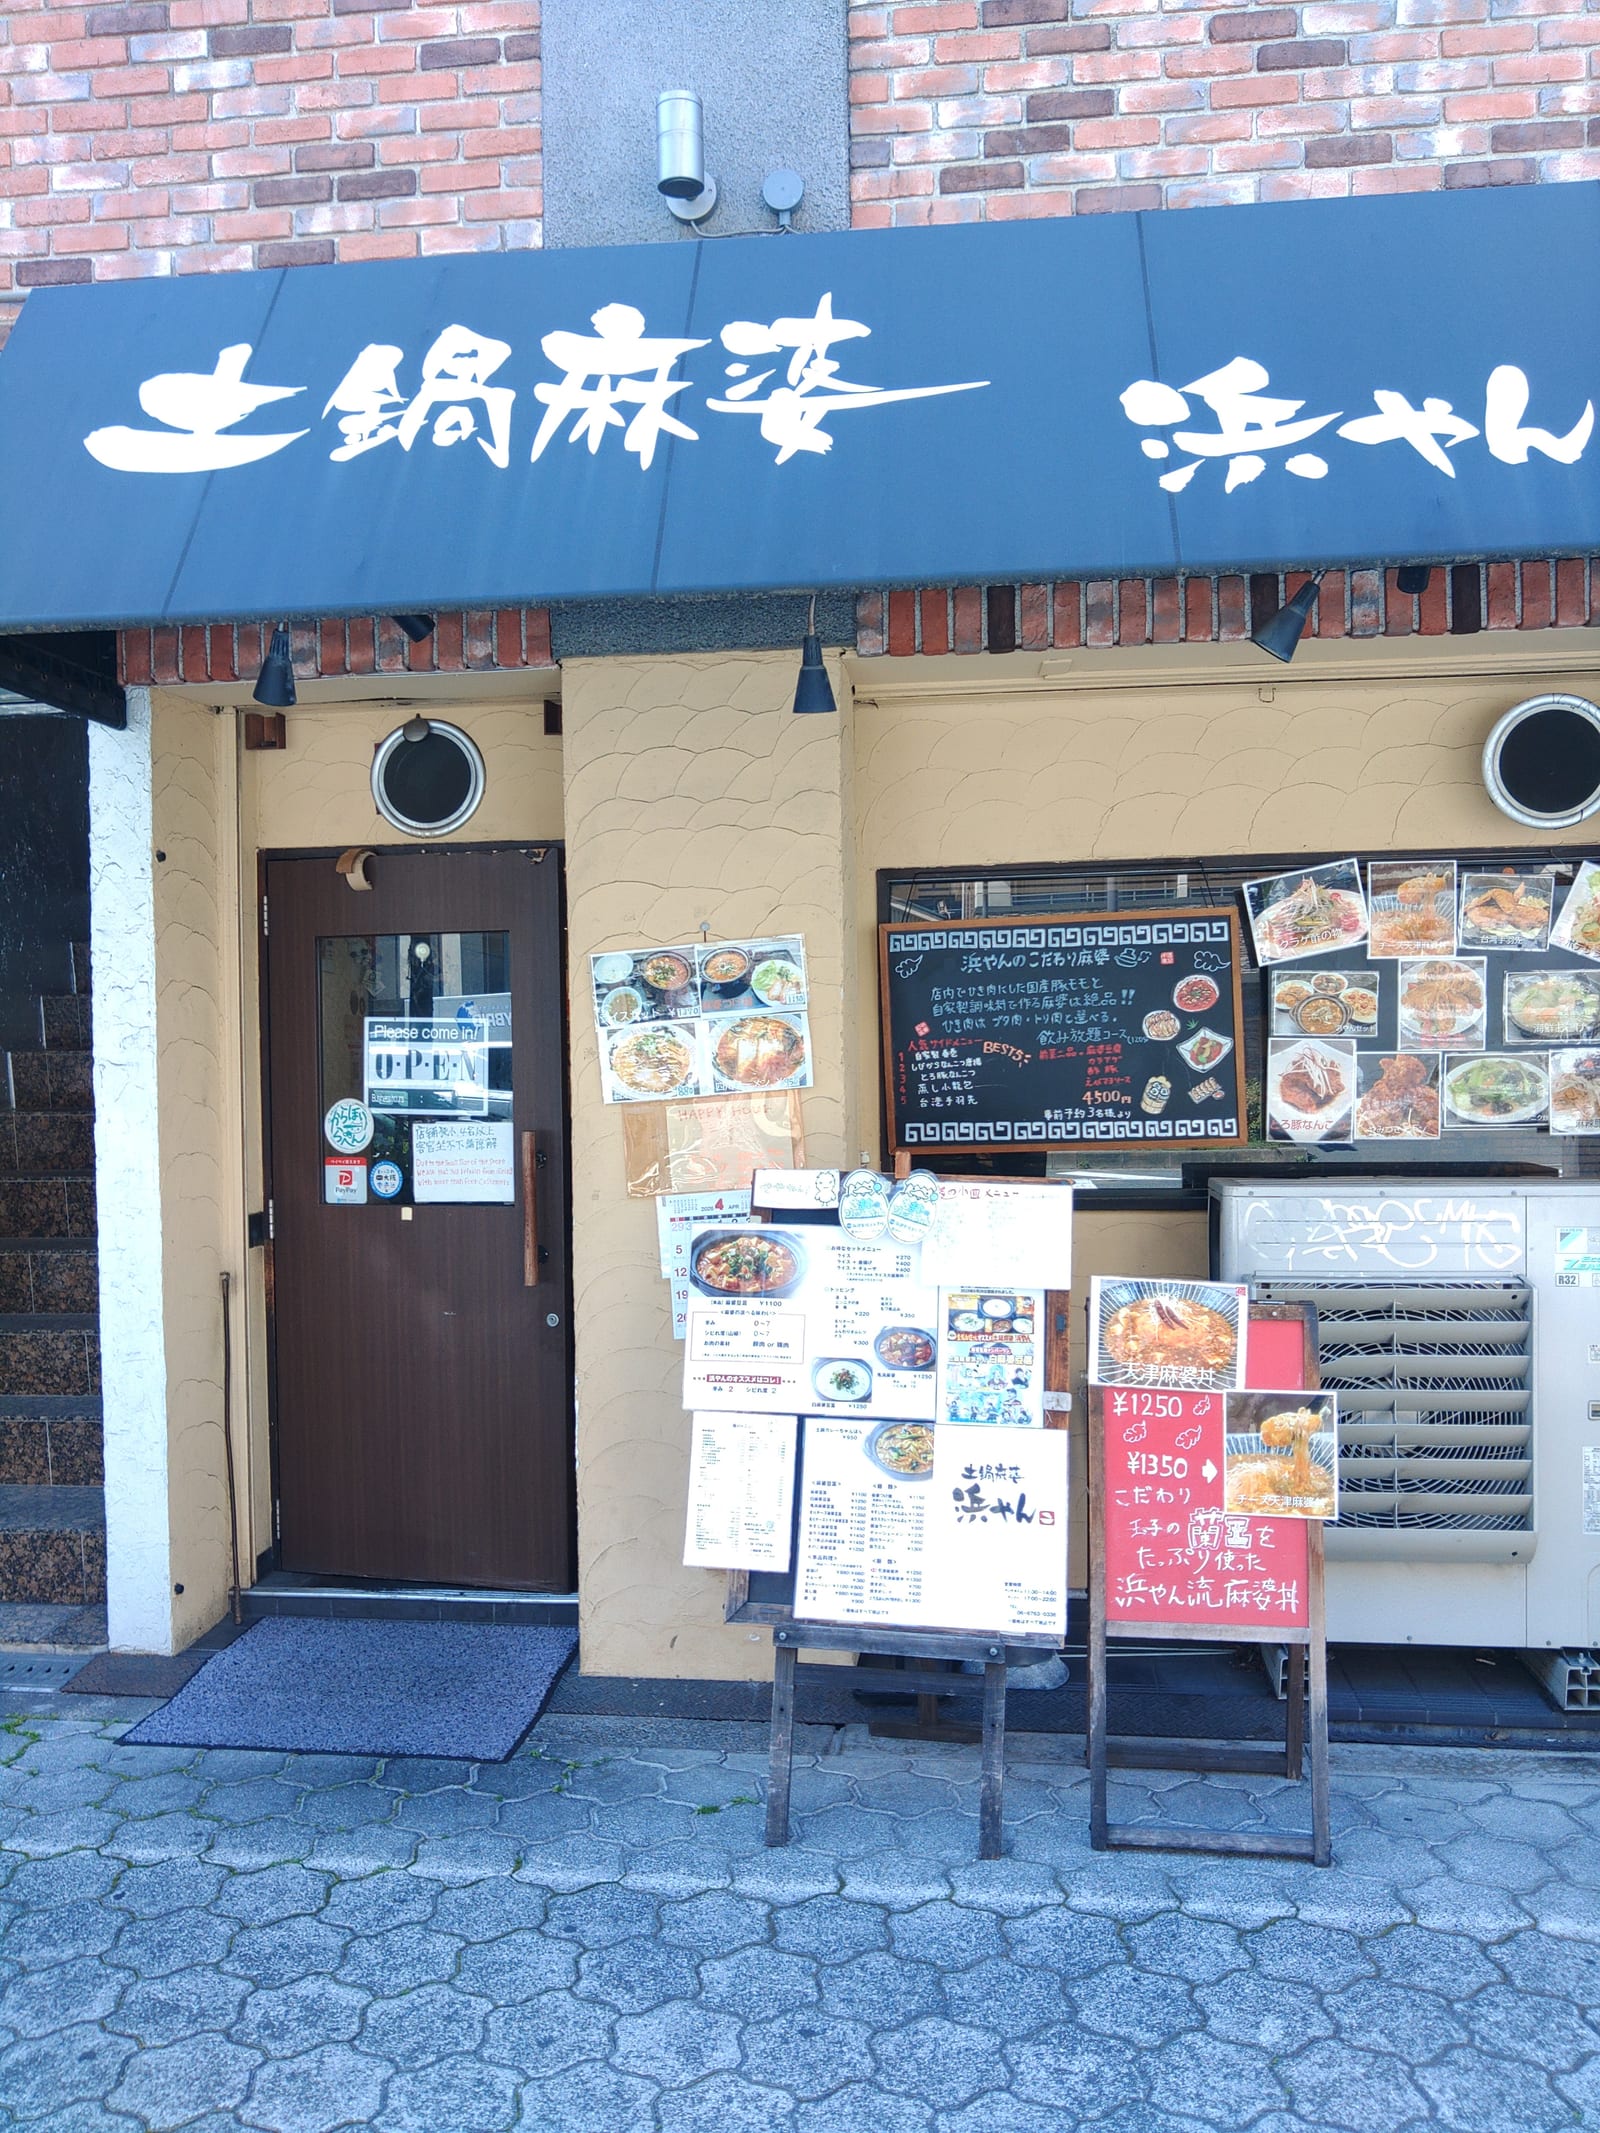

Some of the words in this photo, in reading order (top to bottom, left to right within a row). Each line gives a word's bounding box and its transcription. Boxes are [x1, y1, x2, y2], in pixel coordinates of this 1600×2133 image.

[83, 292, 991, 474] 土鍋麻婆
[1119, 357, 1597, 493] 浜やん
[960, 948, 1110, 973] 浜やんのこだわり麻婆
[374, 1025, 419, 1039] Please
[422, 1027, 459, 1040] come
[461, 1025, 479, 1040] in!
[1082, 1090, 1132, 1105] 4500円
[335, 1187, 358, 1196] PayPay
[715, 1198, 724, 1210] 4
[671, 1223, 684, 1232] 29
[675, 1245, 682, 1254] 5
[674, 1267, 687, 1277] 12
[1558, 1275, 1577, 1285] R32
[676, 1290, 688, 1299] 19
[1120, 1361, 1216, 1386] 天津麻婆丼
[1112, 1391, 1182, 1417] ¥1250
[1126, 1452, 1188, 1478] ¥1350
[952, 1483, 1036, 1524] 浜やん
[1114, 1485, 1191, 1507] こだわり
[1137, 1545, 1268, 1575] たっぷり使った
[1114, 1573, 1300, 1614] 浜やん流麻婆丼
